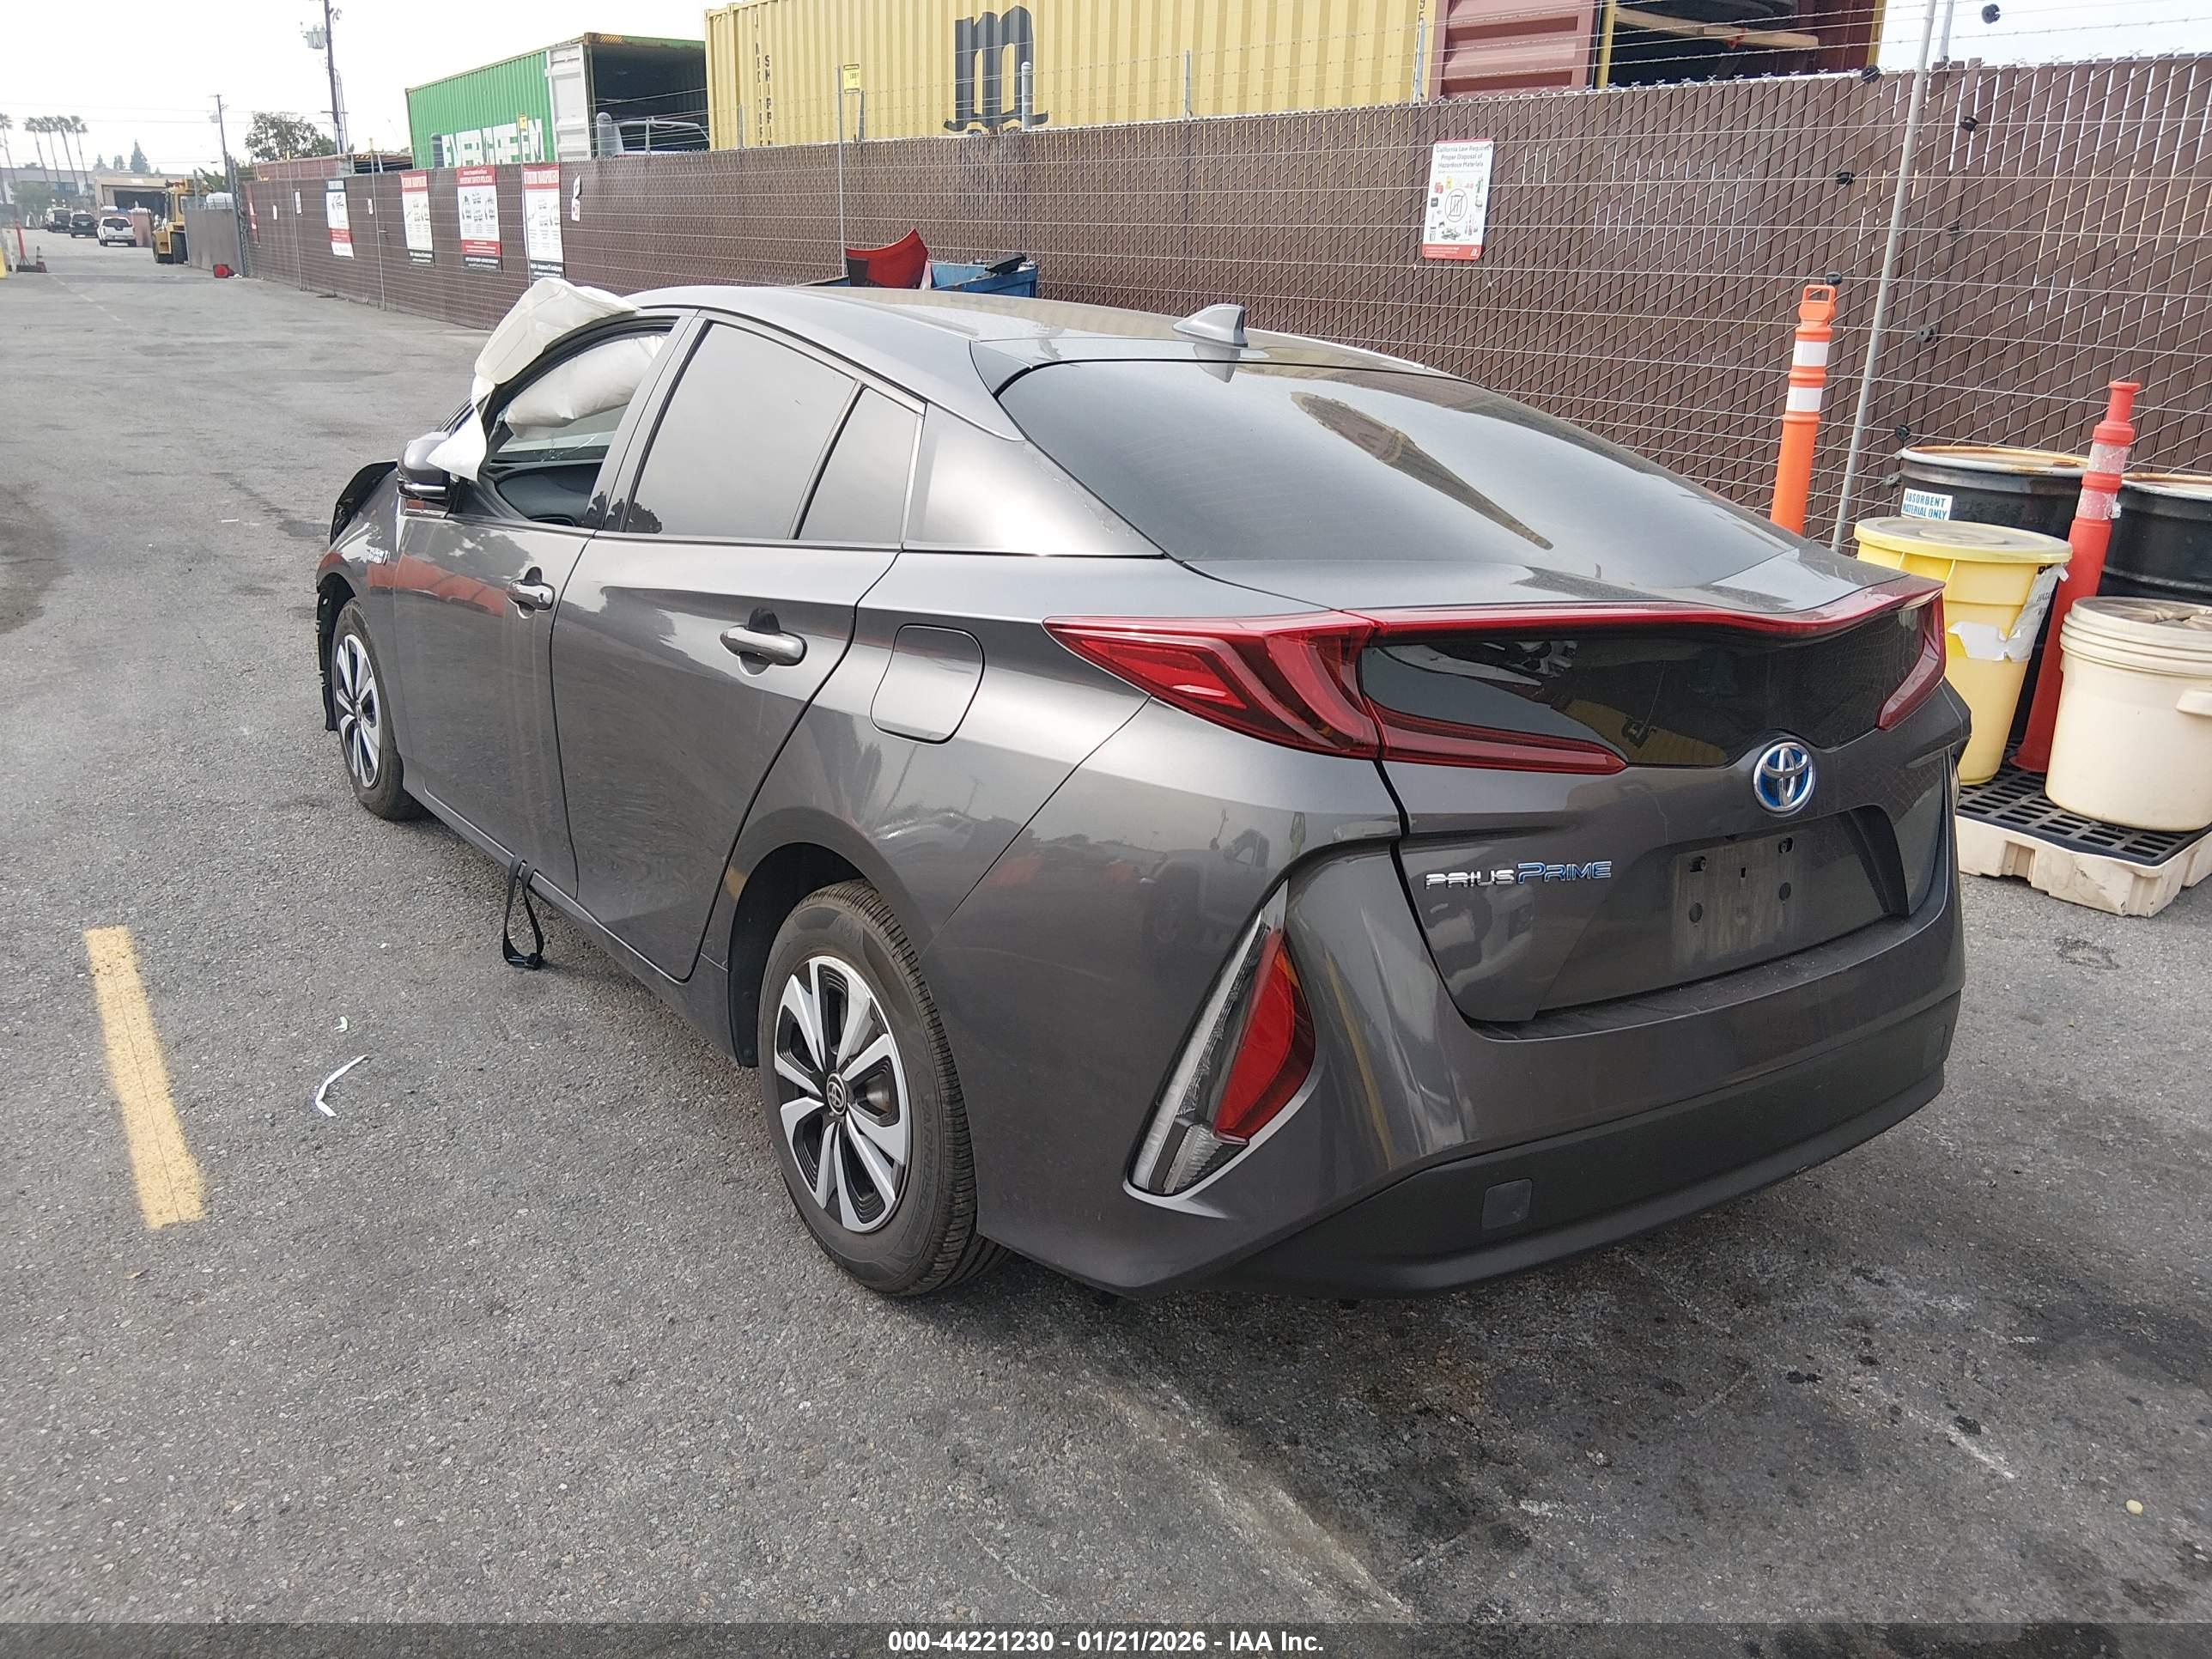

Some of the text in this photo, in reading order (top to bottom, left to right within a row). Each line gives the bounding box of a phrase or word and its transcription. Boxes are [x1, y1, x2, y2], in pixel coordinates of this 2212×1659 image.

[1436, 144, 1458, 153] California
[1905, 491, 1946, 507] ABSORBENT
[1902, 502, 1948, 520] MATERIAL ONLY
[1425, 860, 1612, 890] PRIUS PRIME
